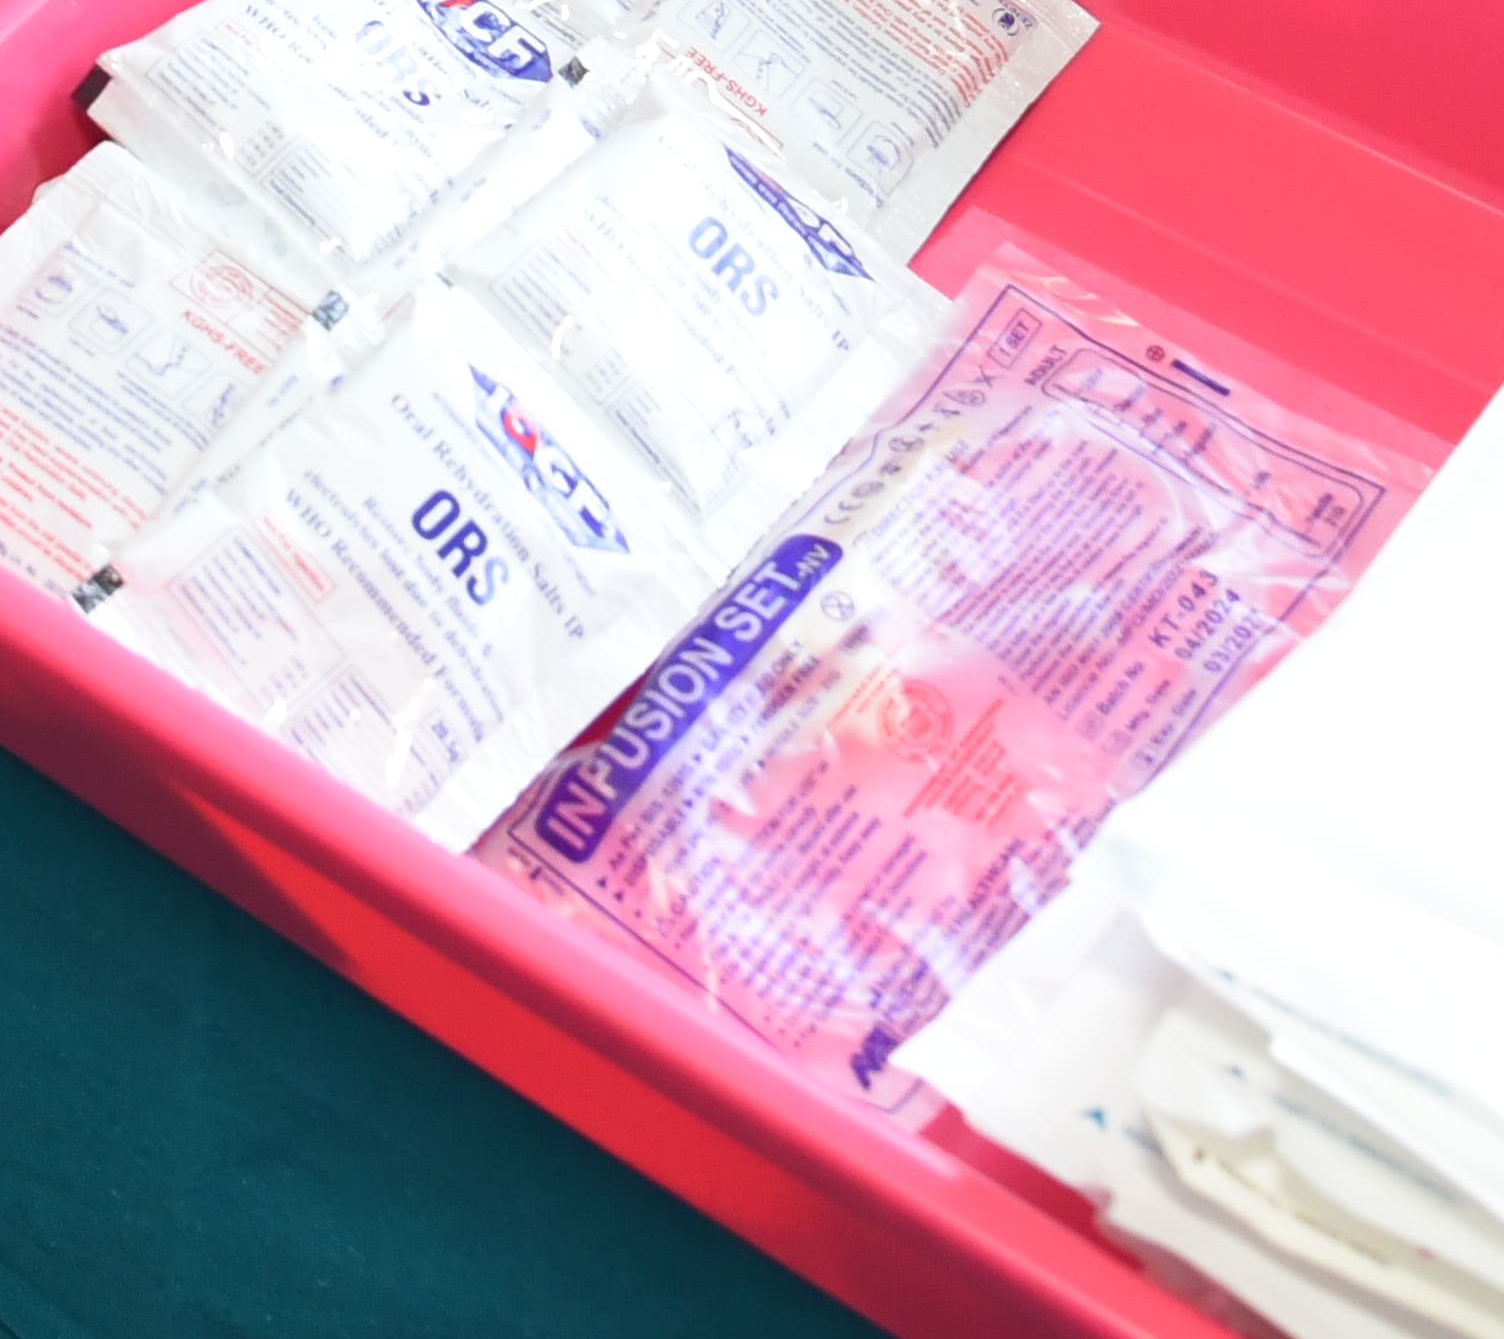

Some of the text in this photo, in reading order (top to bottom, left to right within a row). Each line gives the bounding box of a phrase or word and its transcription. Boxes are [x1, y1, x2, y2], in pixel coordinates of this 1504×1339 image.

[680, 42, 771, 120] KGHS-FREE
[681, 211, 784, 322] ORS
[1004, 319, 1033, 350] SET
[300, 463, 384, 553] electrolytes
[385, 389, 587, 643] Oral Rehydration Salts IP
[402, 481, 518, 610] ORS
[279, 485, 334, 542] WHO
[327, 535, 439, 668] Recommended
[709, 558, 805, 647] SET
[1146, 566, 1221, 651] KT-043
[1171, 583, 1243, 663] 04/2024
[543, 635, 738, 863] INFUSION
